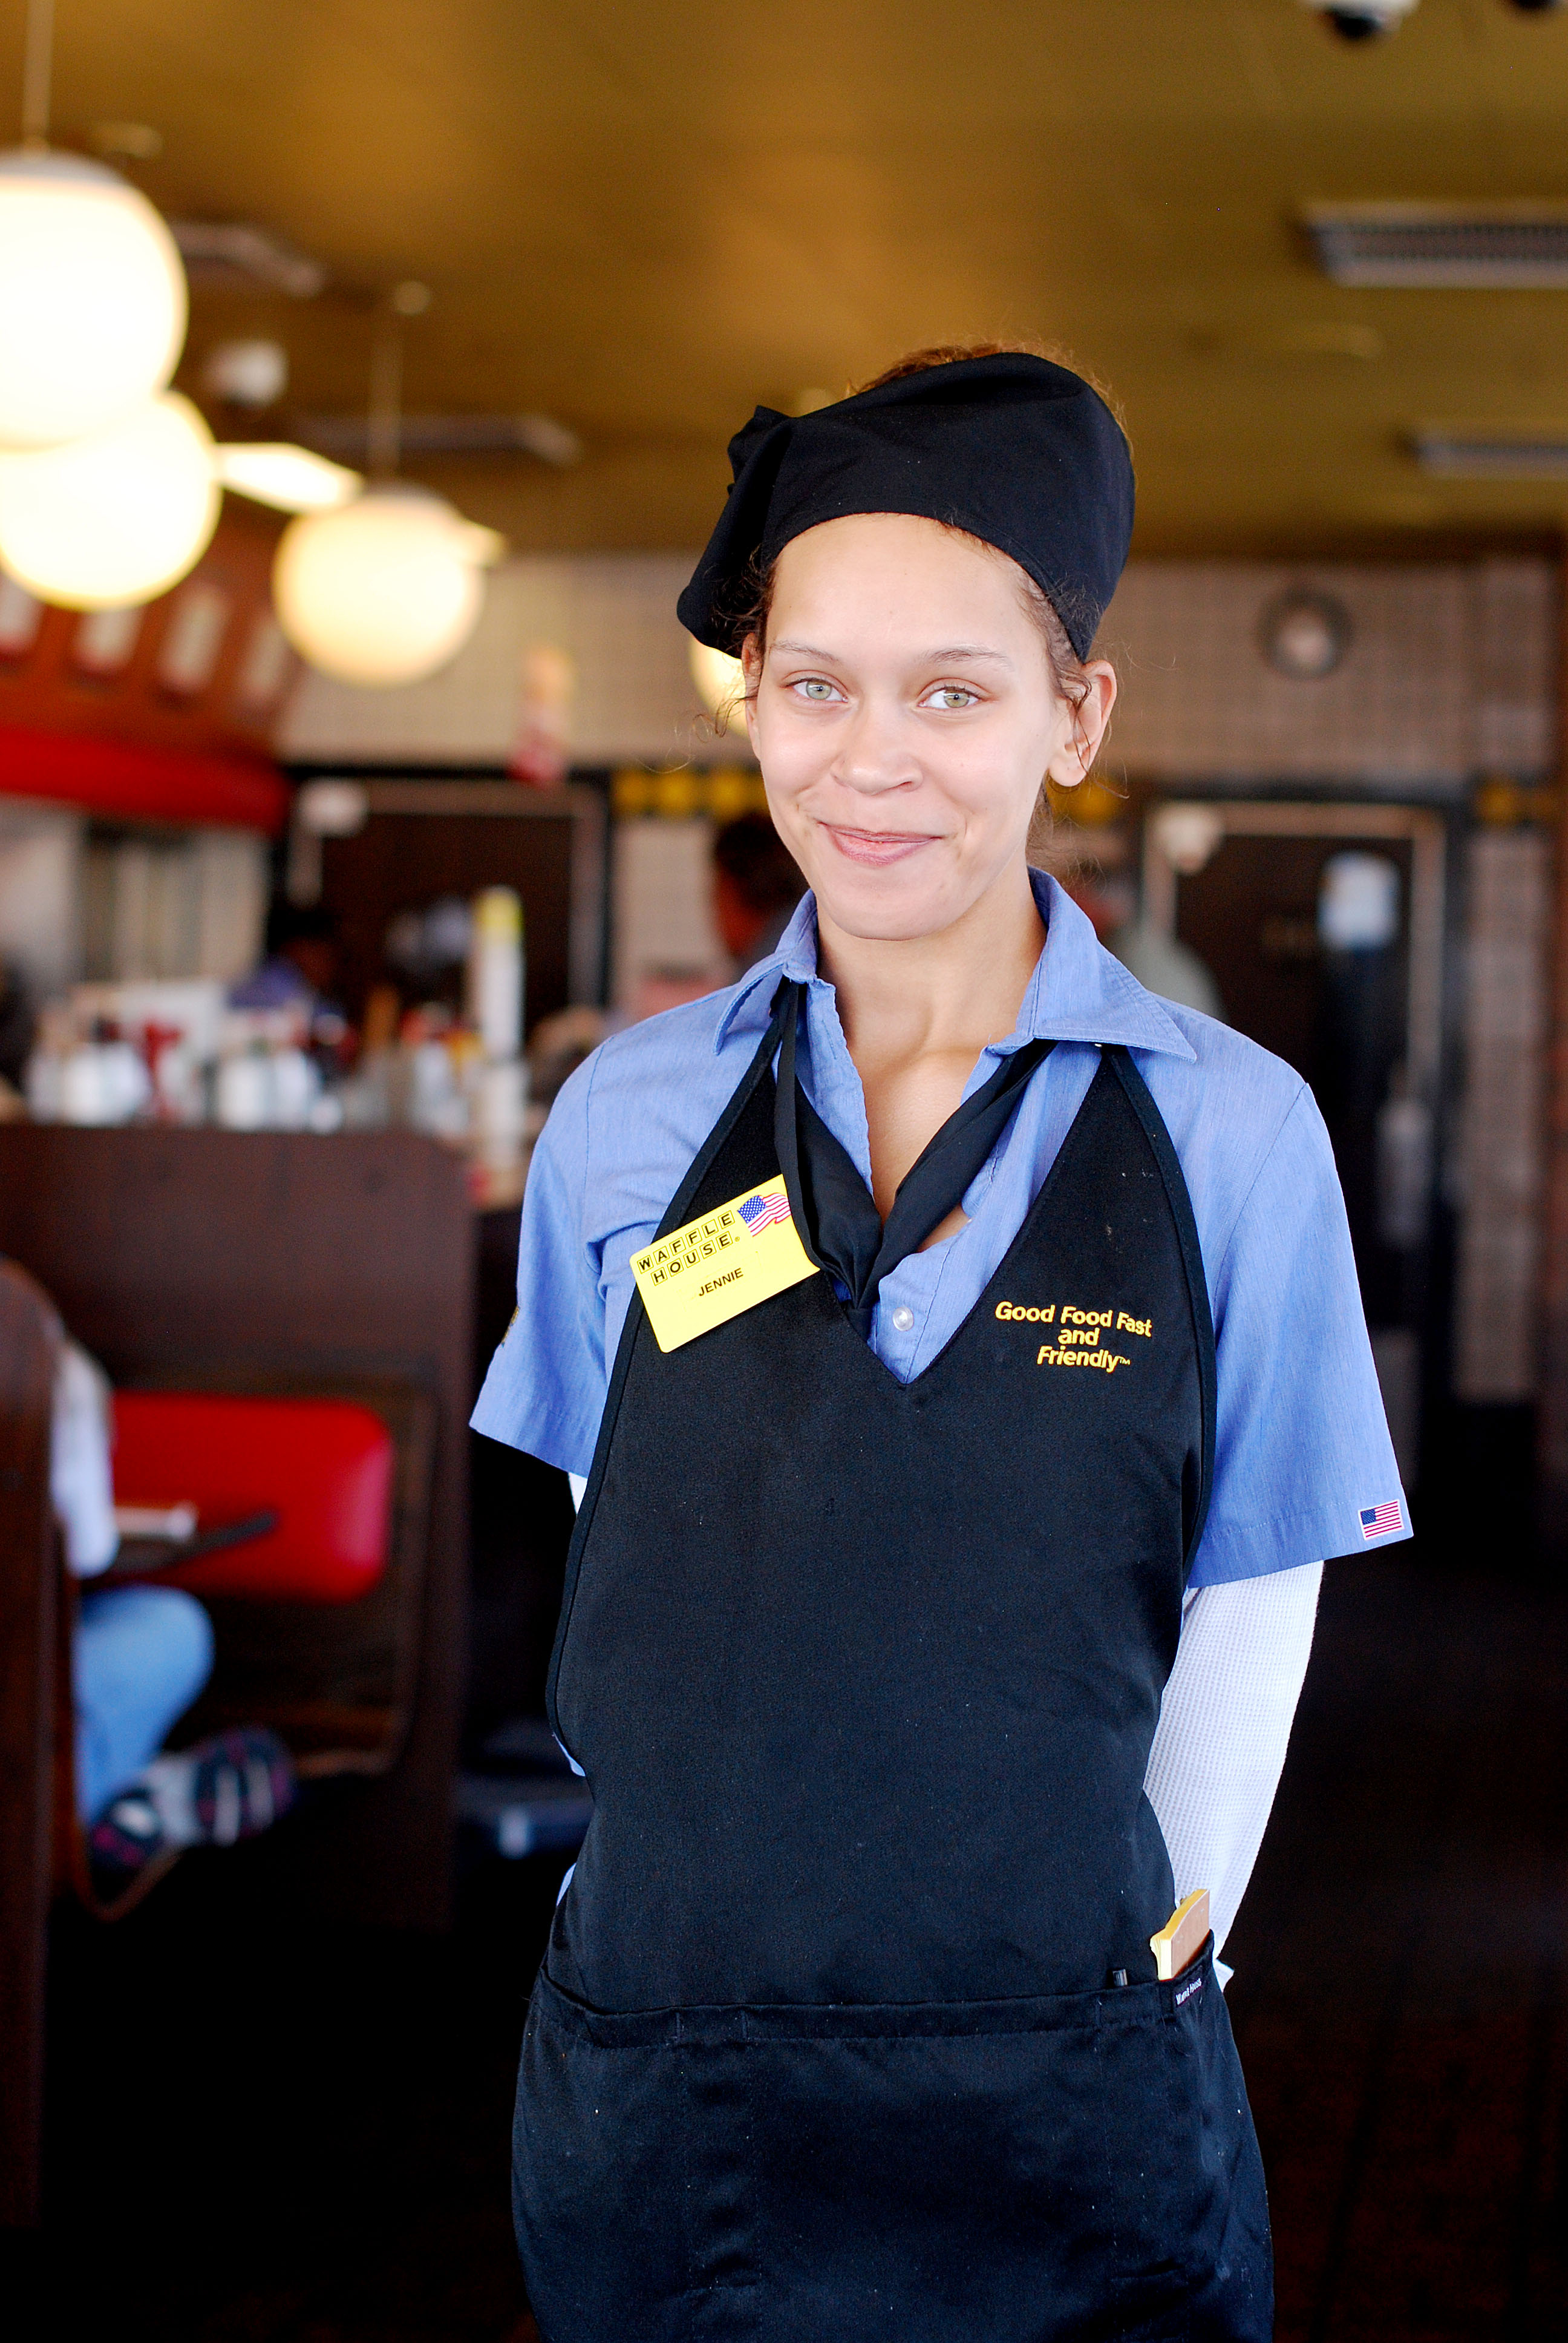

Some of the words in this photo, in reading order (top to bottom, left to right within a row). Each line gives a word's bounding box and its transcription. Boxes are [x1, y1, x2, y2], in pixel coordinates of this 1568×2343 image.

[639, 1213, 733, 1271] WAFFLE
[698, 1267, 744, 1297] JENNIE
[995, 1301, 1056, 1323] Good
[1060, 1306, 1113, 1328] Food
[1116, 1311, 1152, 1337] Fast
[1057, 1327, 1100, 1346] and
